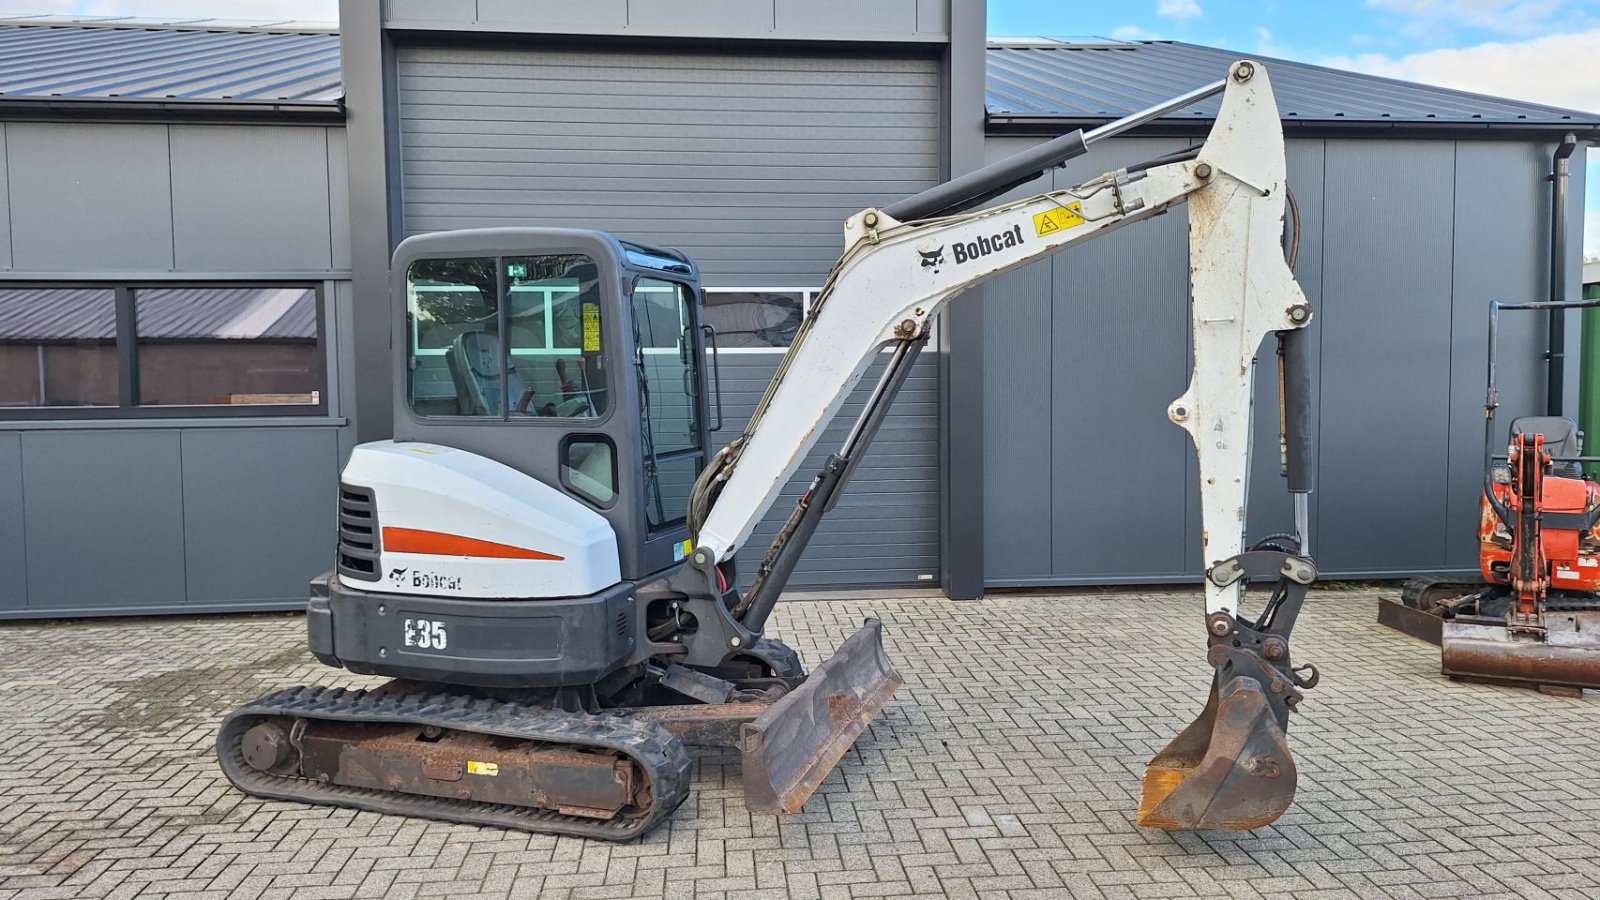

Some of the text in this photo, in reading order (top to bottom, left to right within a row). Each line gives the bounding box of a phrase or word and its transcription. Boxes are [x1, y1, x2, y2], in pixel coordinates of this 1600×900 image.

[952, 224, 1025, 264] Bobcat
[413, 570, 462, 590] Bobcat
[404, 618, 447, 650] E35
